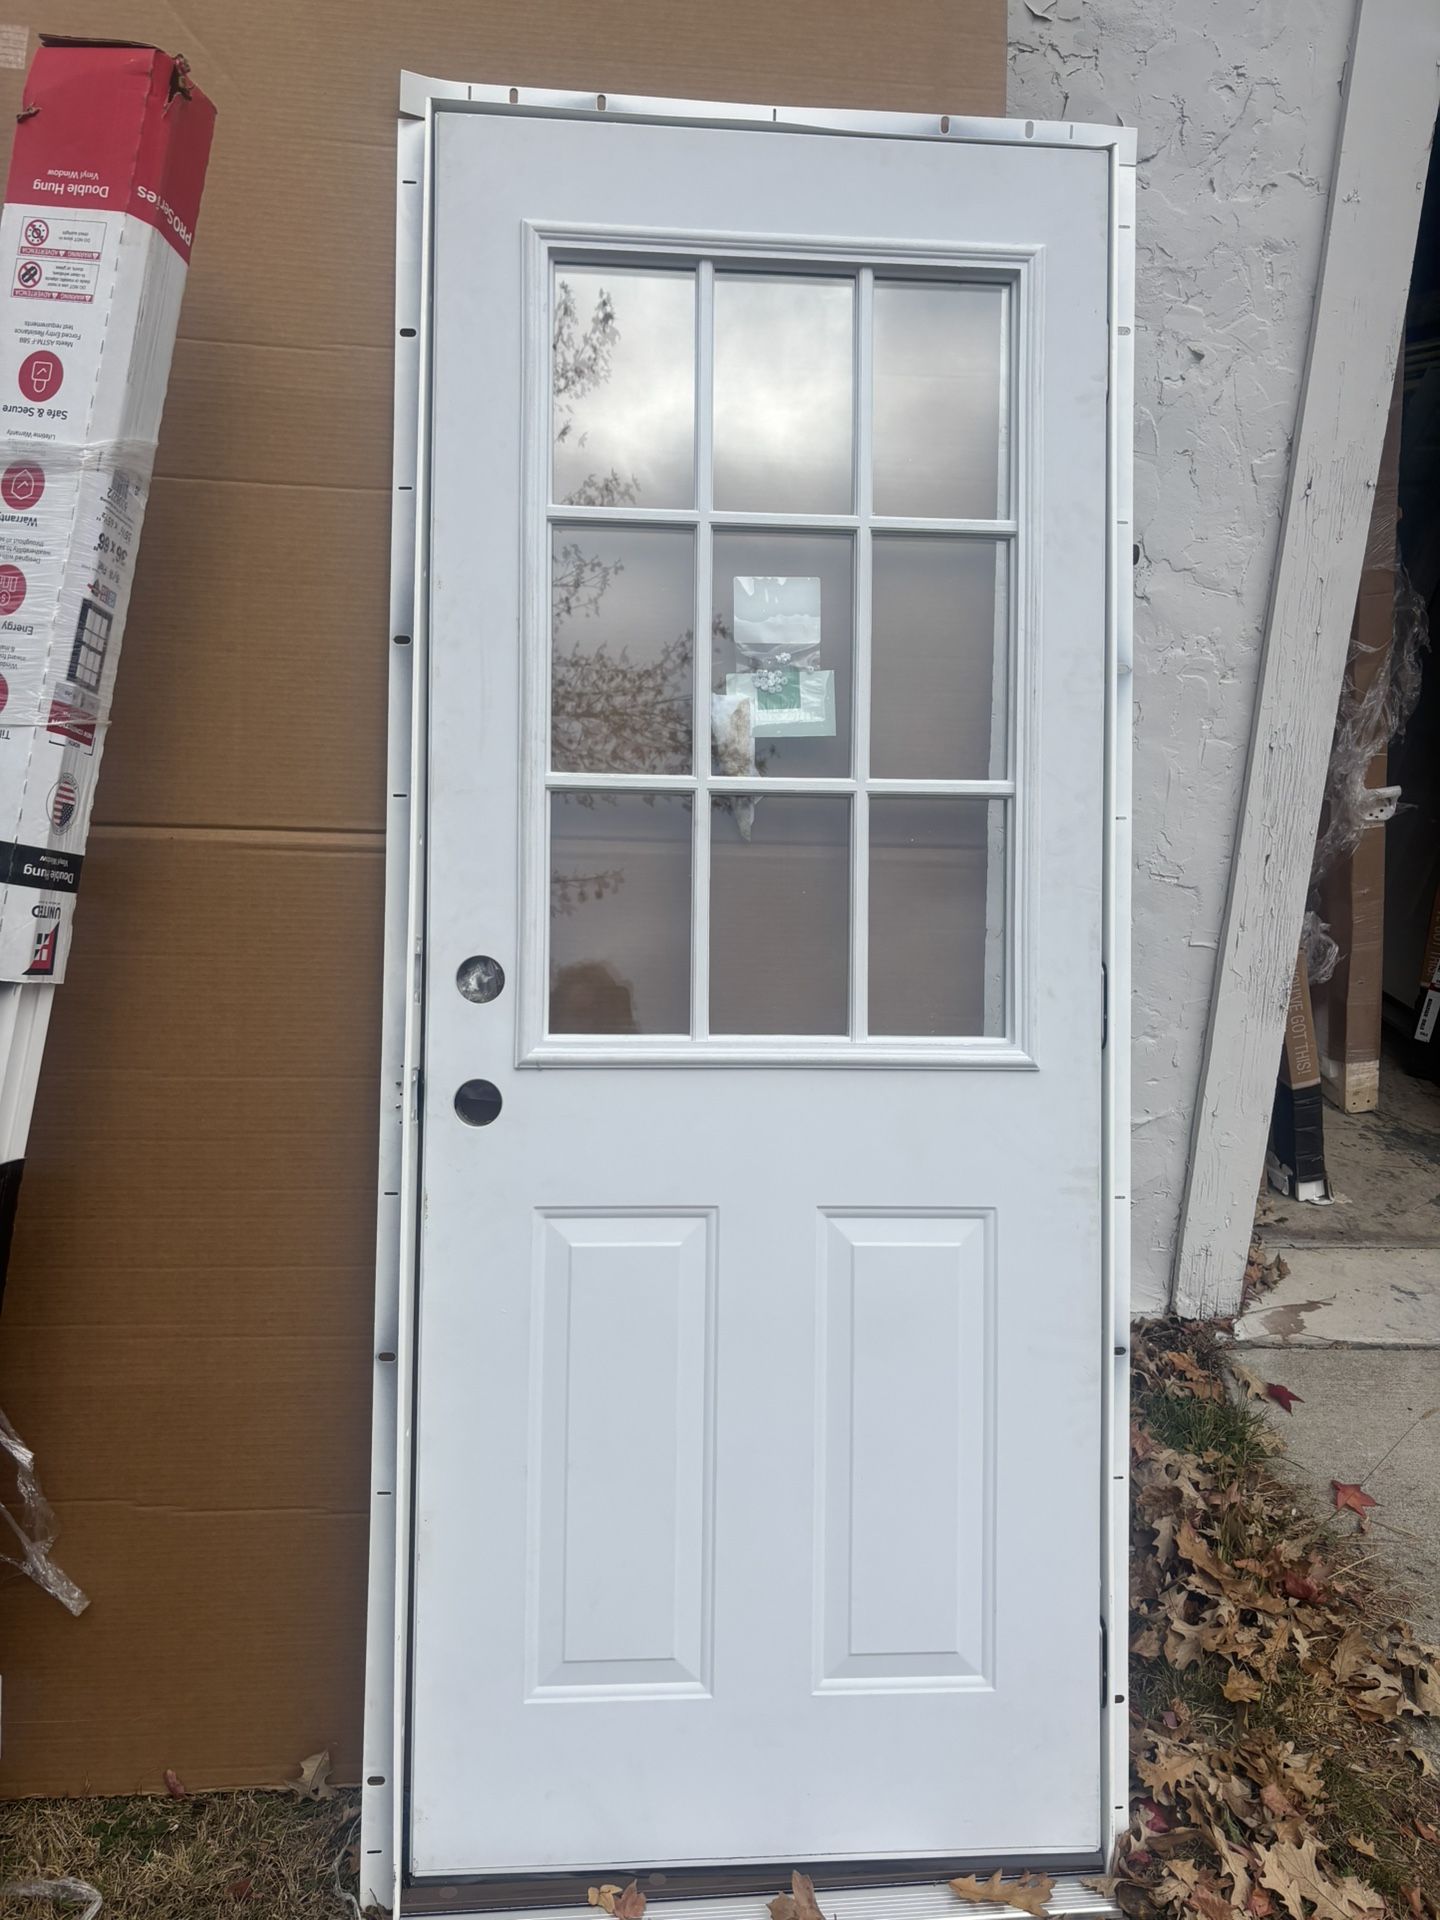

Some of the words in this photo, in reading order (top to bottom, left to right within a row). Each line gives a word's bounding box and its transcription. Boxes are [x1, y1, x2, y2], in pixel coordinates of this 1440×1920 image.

[47, 168, 78, 178] Window
[80, 171, 99, 180] Vinyl
[32, 179, 64, 195] Hung
[67, 183, 109, 198] Double
[60, 292, 85, 300] WARNING
[24, 320, 62, 329] requirements
[61, 332, 82, 340] Forced
[2, 404, 35, 417] Secure
[36, 407, 45, 418] &
[46, 408, 68, 420] Safe
[6, 429, 32, 438] Warranty
[0, 511, 38, 528] Warrant
[1, 620, 34, 636] Energy
[32, 904, 61, 920] UNITED
[1291, 1014, 1307, 1041] GOT
[1295, 1043, 1312, 1076] THIS!
